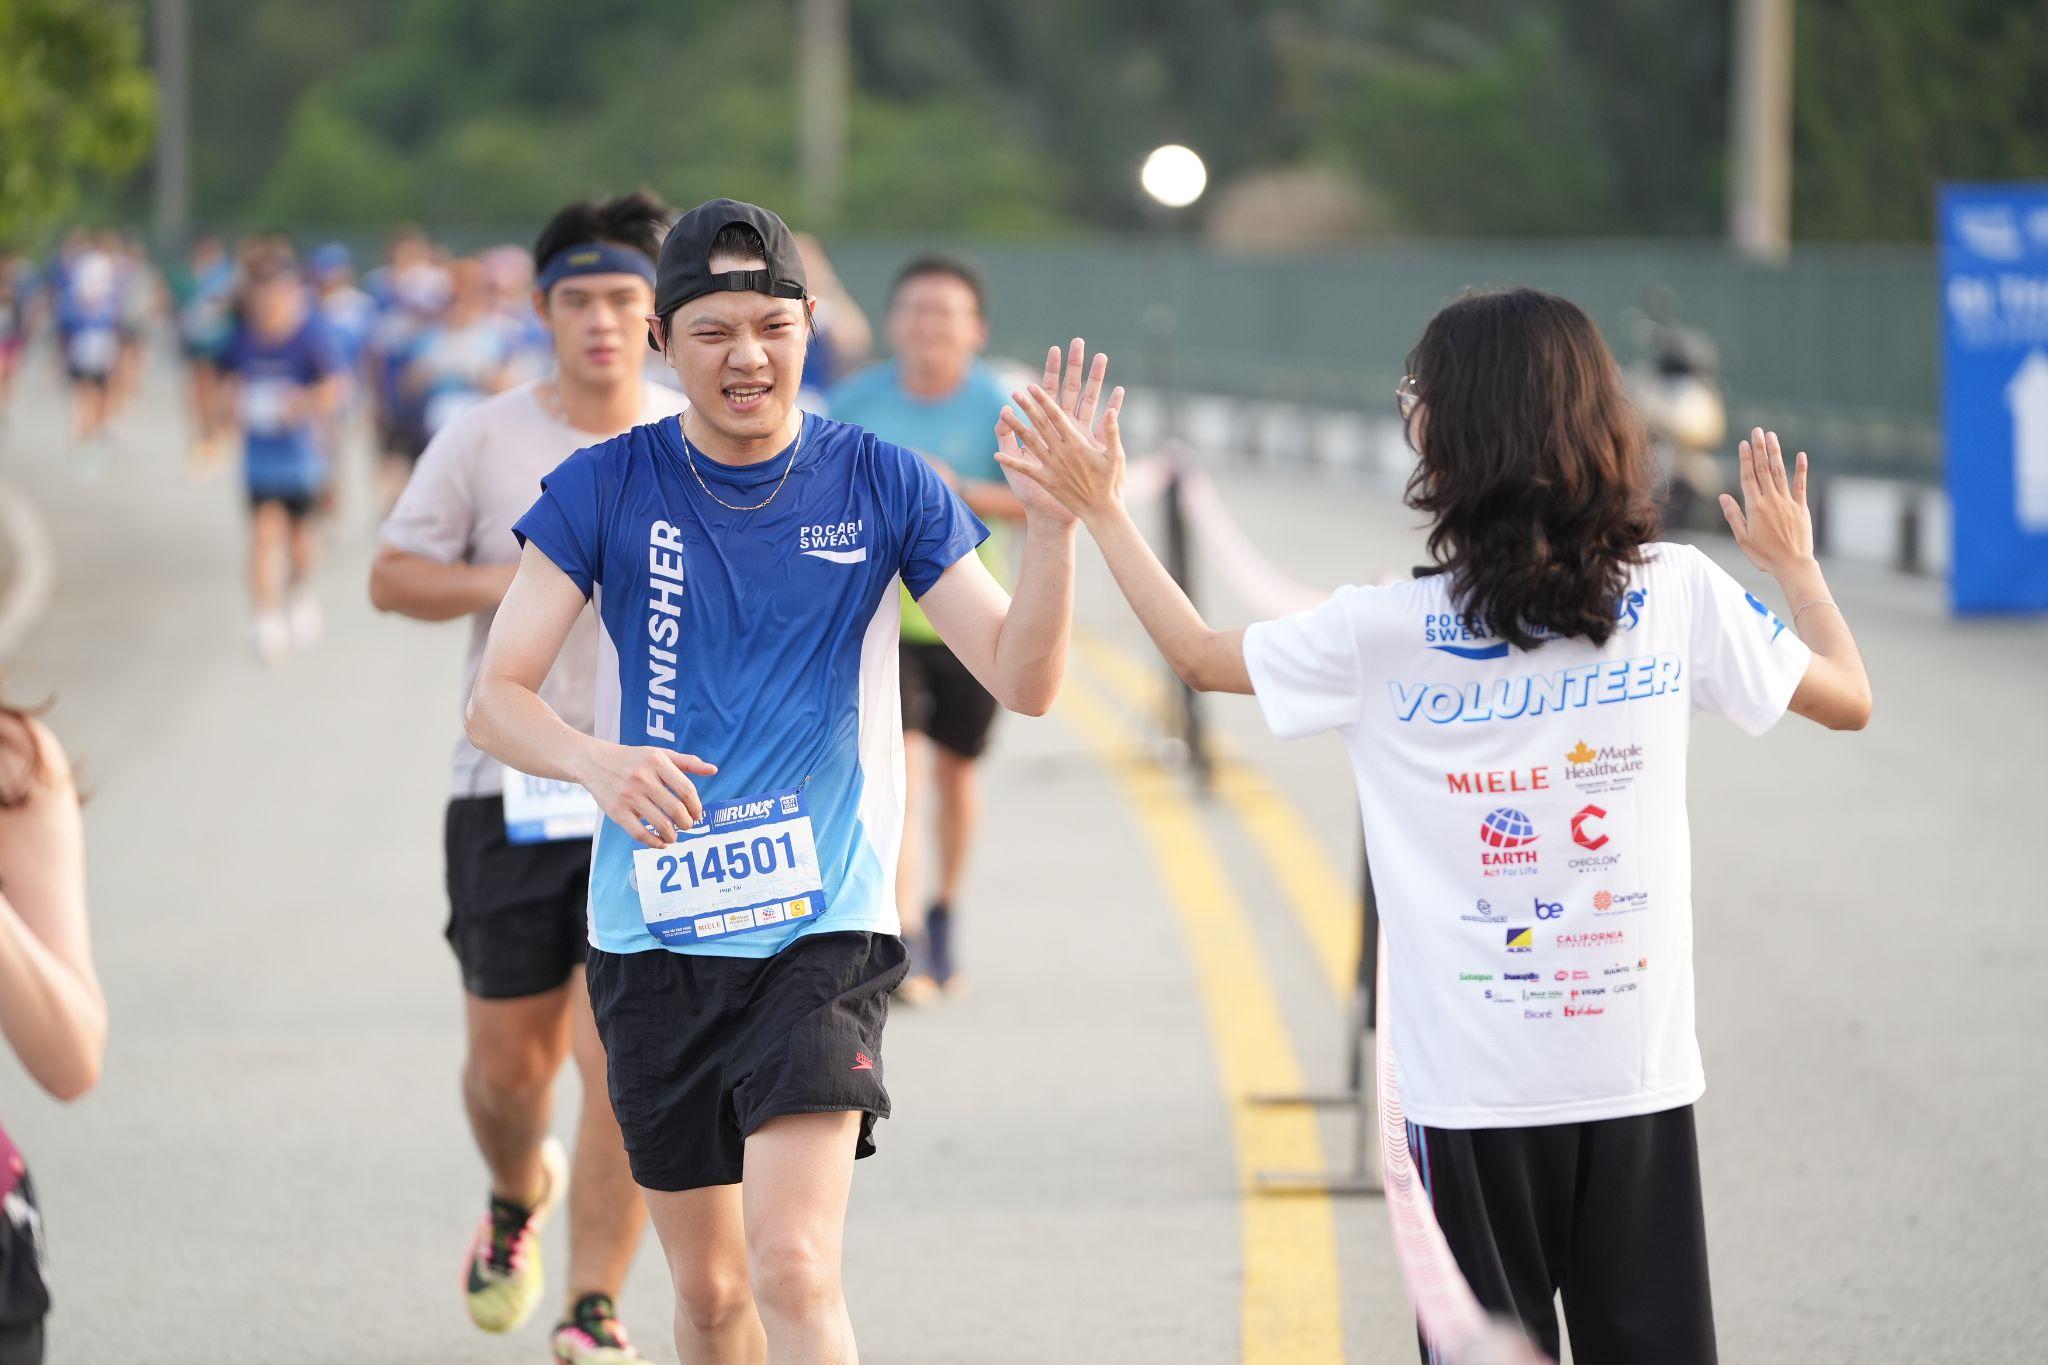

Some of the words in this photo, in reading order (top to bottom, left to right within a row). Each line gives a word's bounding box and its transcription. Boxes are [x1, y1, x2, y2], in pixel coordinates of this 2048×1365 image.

[801, 520, 862, 537] POCARI
[800, 532, 857, 549] SWEAT
[646, 519, 684, 743] FINISHER
[1387, 652, 1681, 724] VOLUNTEER
[1597, 743, 1642, 761] Maple
[1565, 760, 1643, 780] Healthcare
[1447, 766, 1550, 794] MIELE
[656, 831, 796, 894] 214501
[1482, 851, 1538, 865] EARTH
[1483, 869, 1500, 877] Act
[1503, 868, 1517, 876] For
[1520, 867, 1538, 875] Life
[1534, 897, 1564, 920] be
[698, 921, 722, 932] MIELE
[1557, 931, 1623, 943] CALIFORNIA
